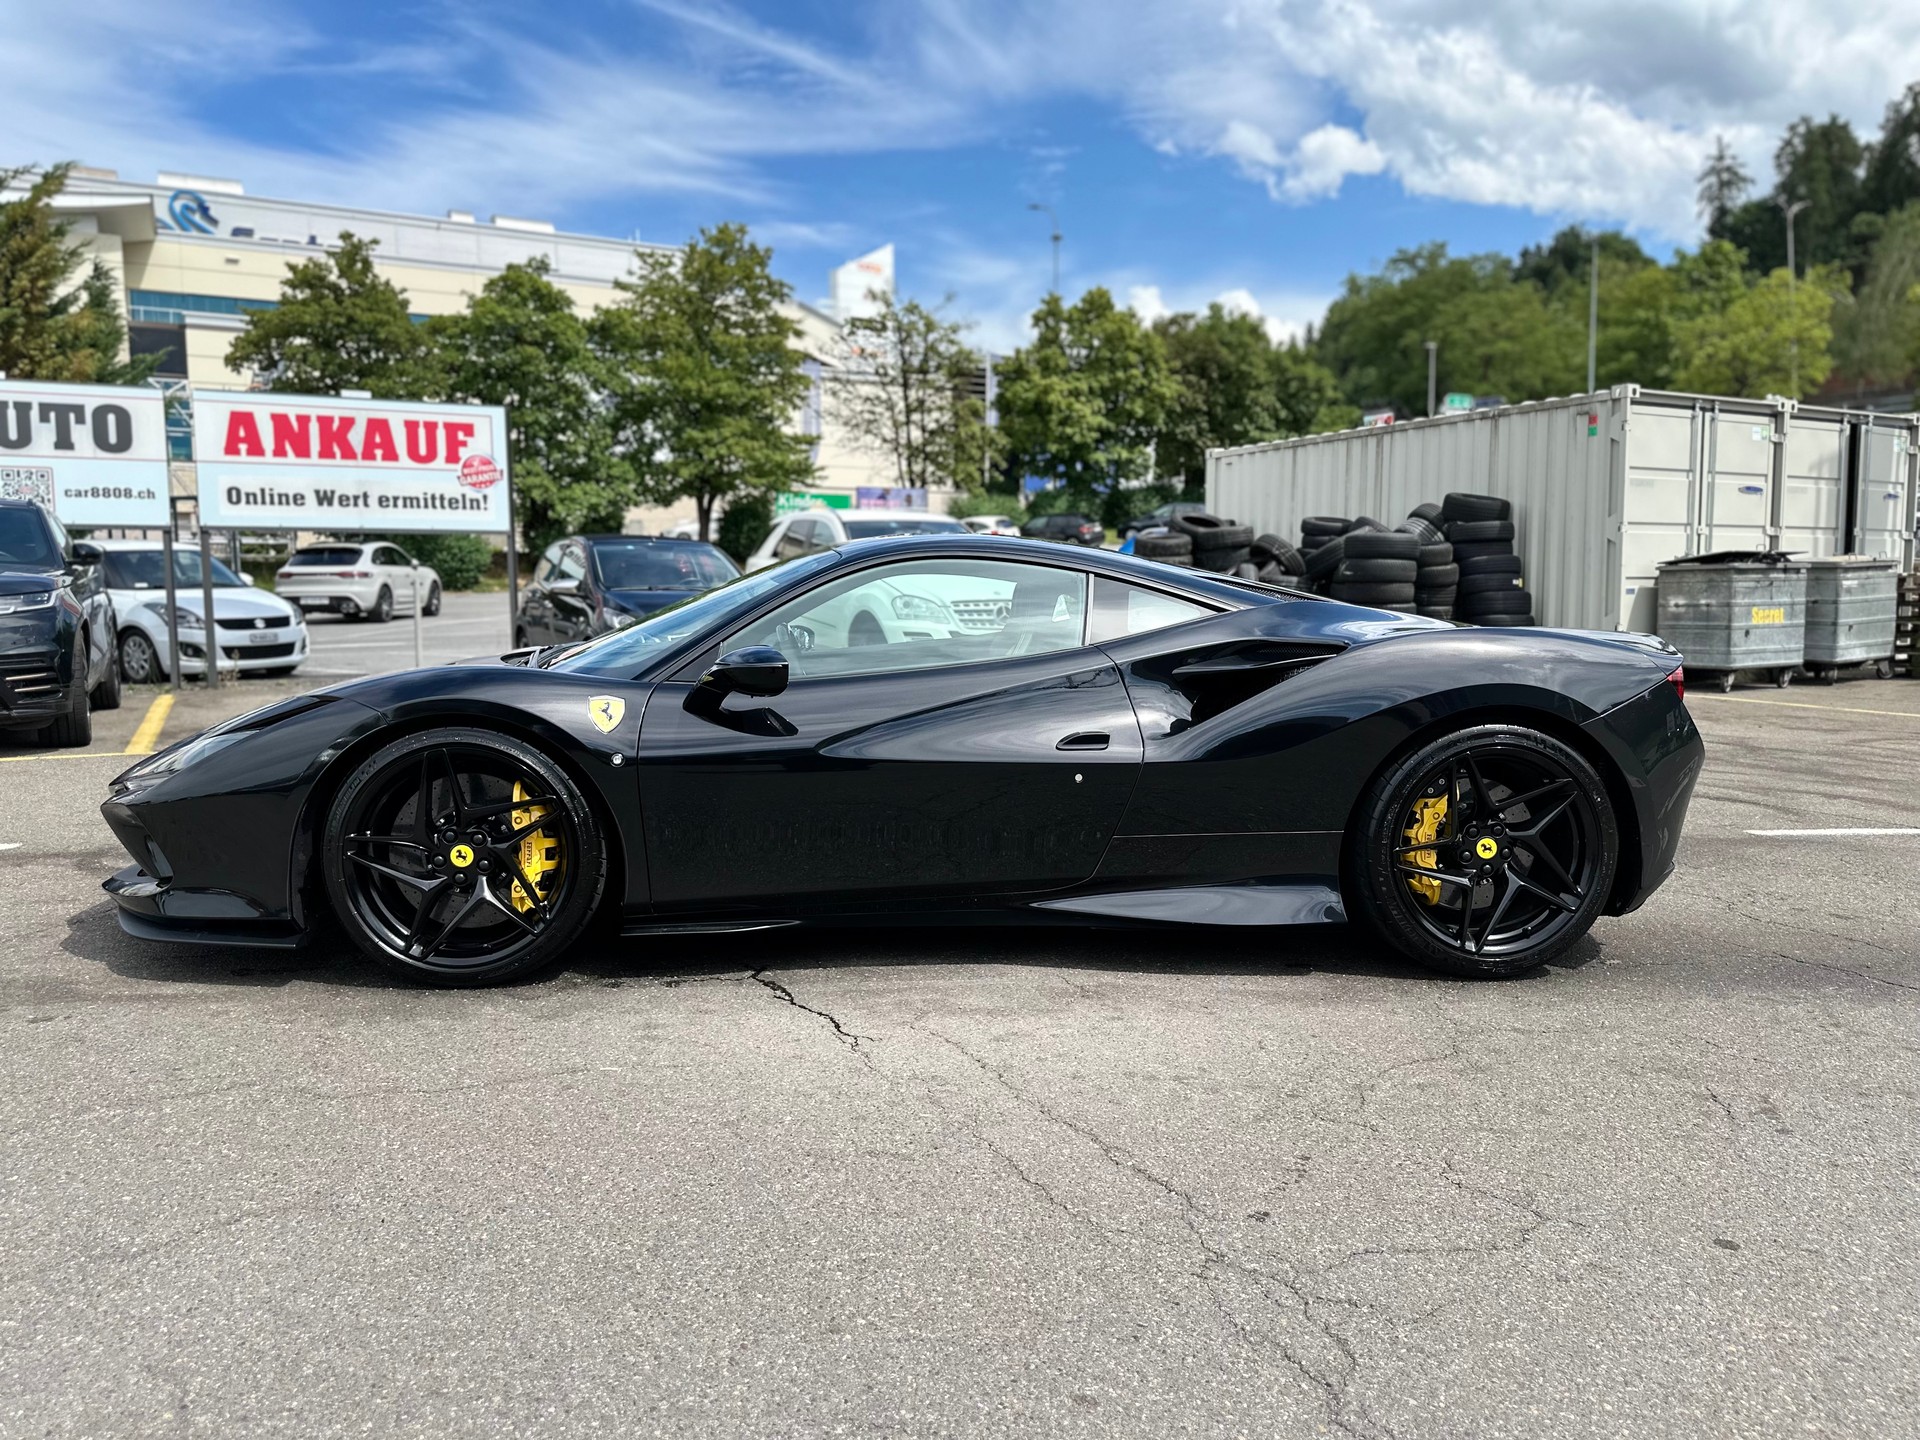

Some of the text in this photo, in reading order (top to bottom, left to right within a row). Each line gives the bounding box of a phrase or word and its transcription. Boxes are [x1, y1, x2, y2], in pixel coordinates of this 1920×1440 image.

[224, 410, 475, 464] ANKAUF
[64, 486, 156, 500] car8808.ch
[226, 486, 488, 511] Online Wert ermitteln!
